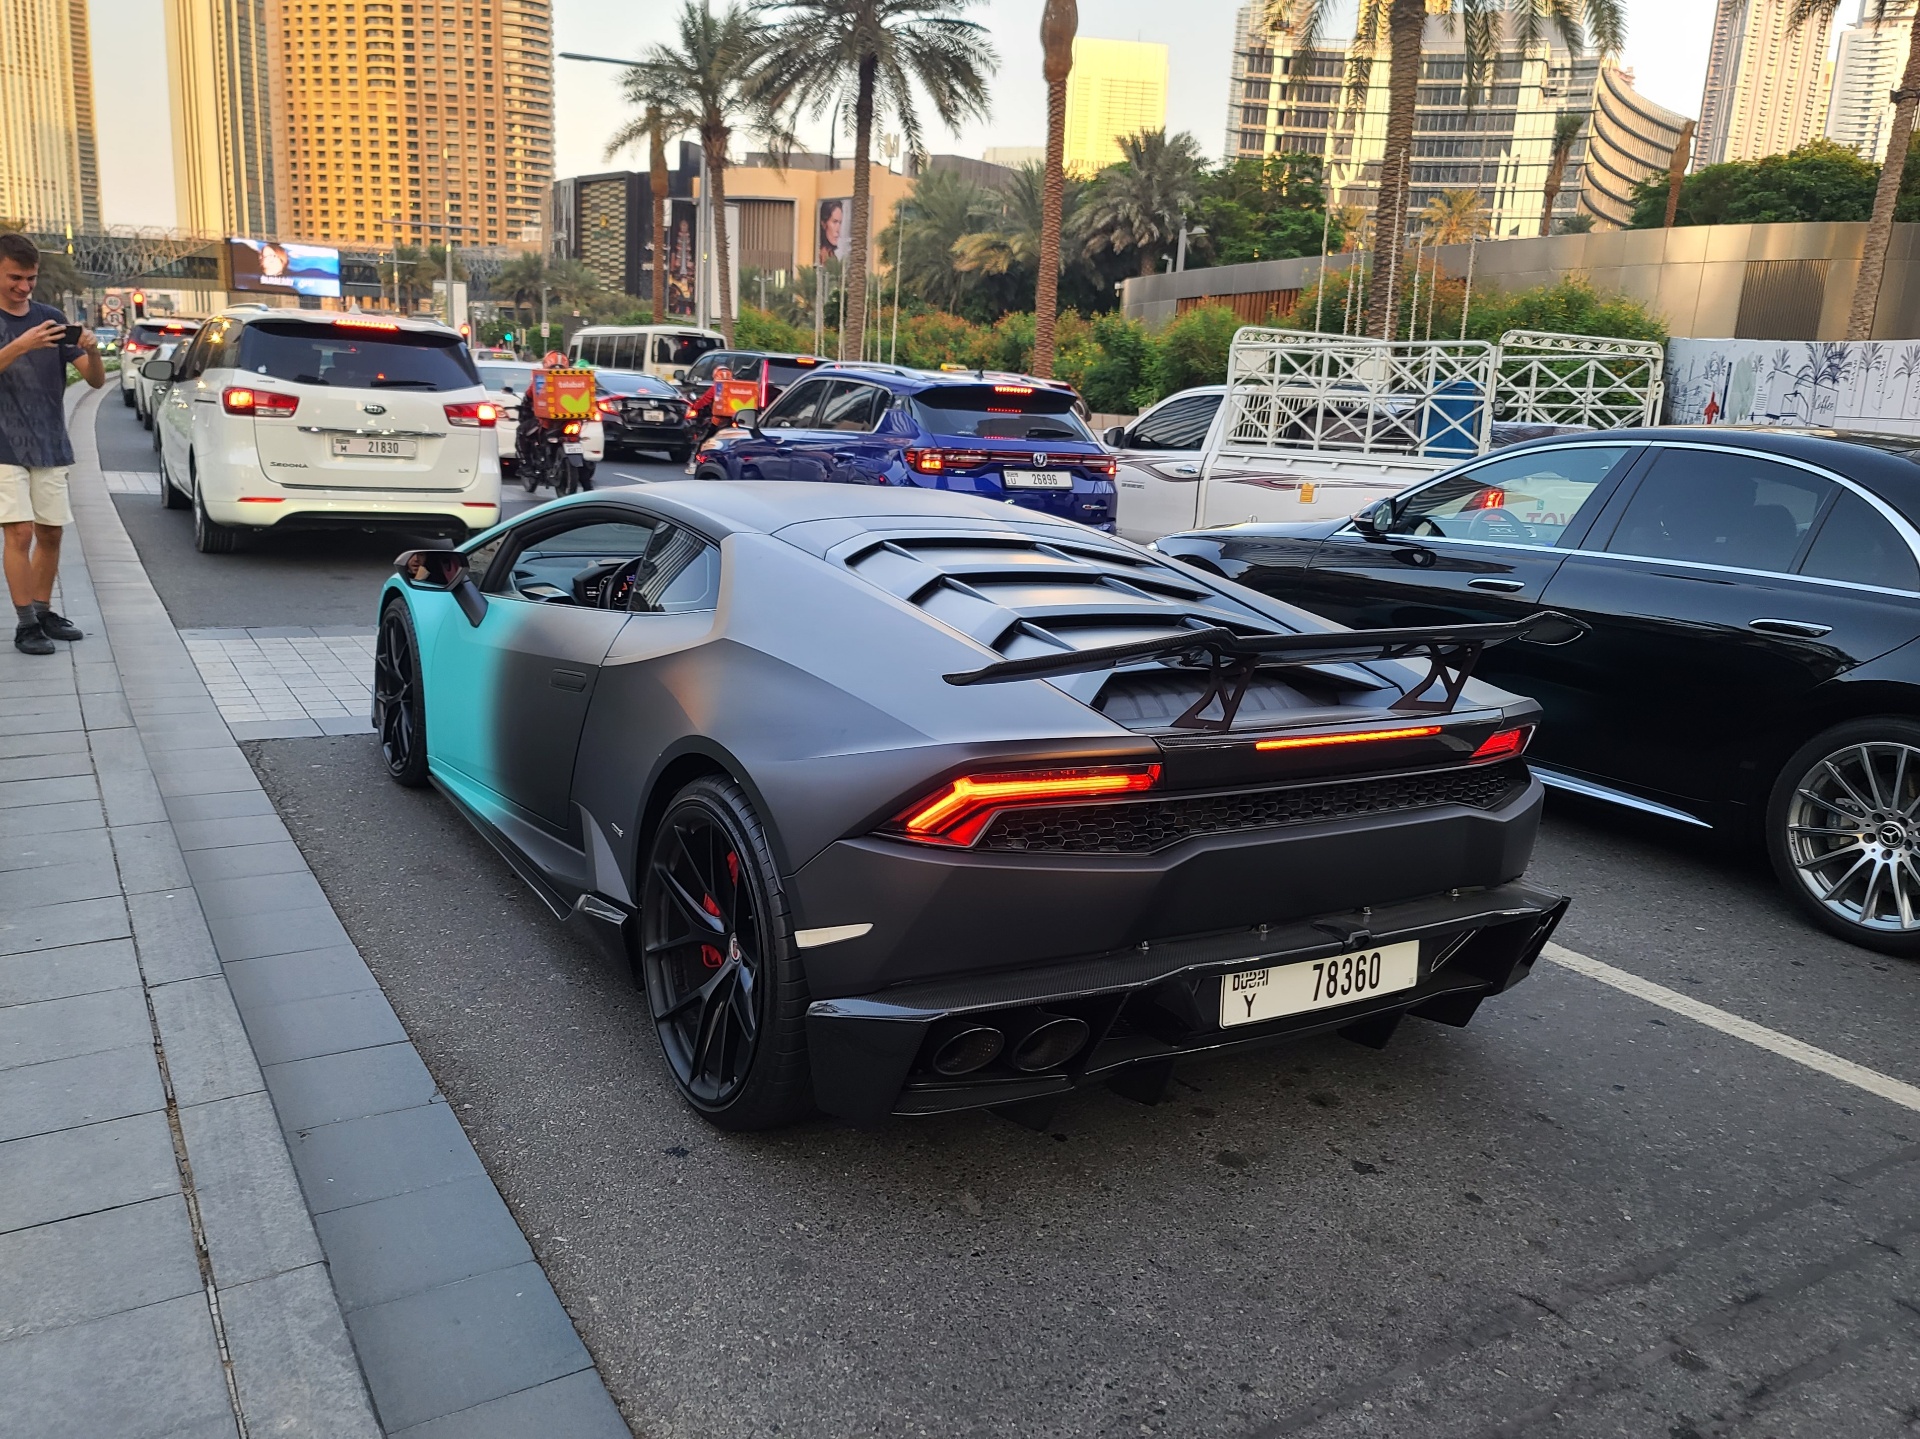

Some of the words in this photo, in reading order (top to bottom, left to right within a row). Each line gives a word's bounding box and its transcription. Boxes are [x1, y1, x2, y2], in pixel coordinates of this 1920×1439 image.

[558, 381, 585, 389] talabat
[368, 441, 399, 454] 21830
[270, 461, 308, 469] SEDONA
[1032, 474, 1058, 485] 26896
[1243, 993, 1257, 1018] Y
[1312, 951, 1381, 1002] 78360
